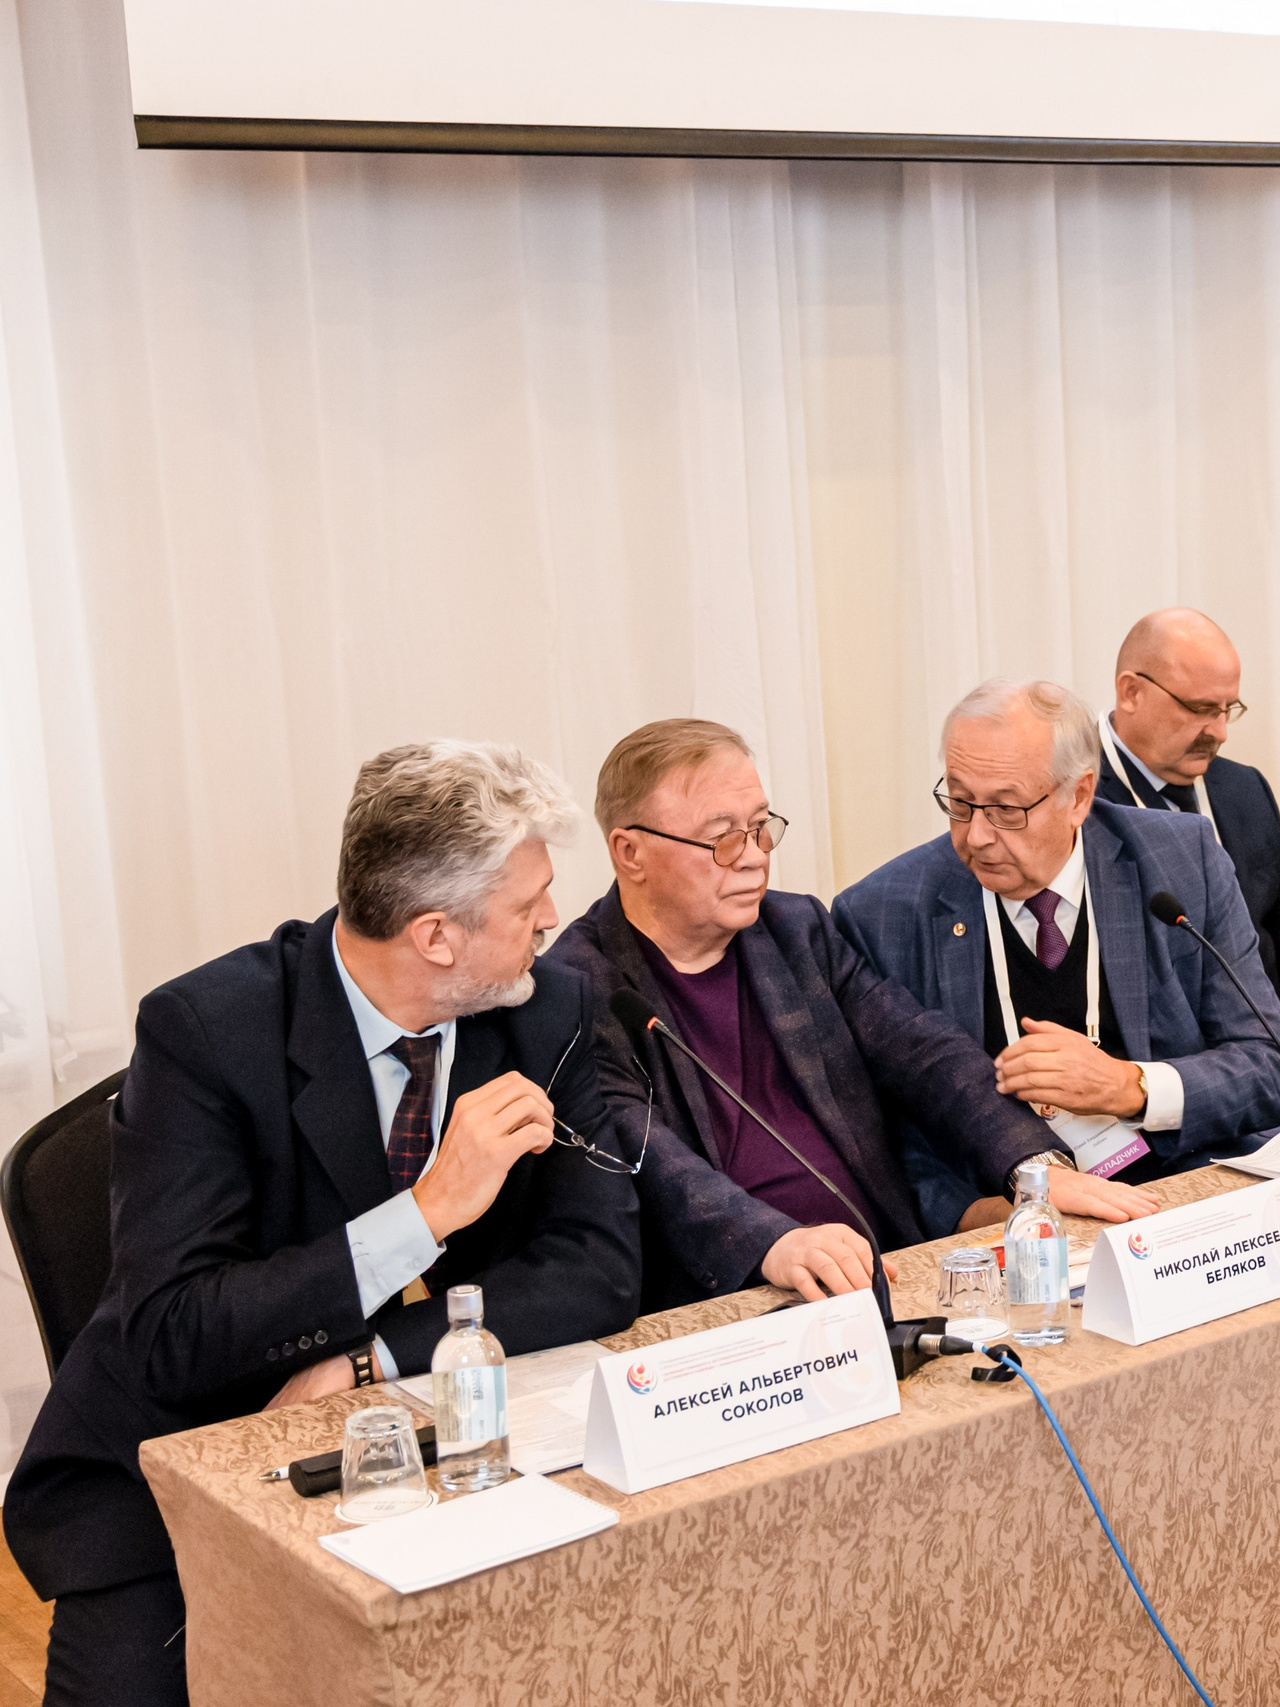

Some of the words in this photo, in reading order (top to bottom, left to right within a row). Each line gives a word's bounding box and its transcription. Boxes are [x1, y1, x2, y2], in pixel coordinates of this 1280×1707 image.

[1091, 1145, 1140, 1178] ОКЛАДЧИК
[1153, 1247, 1221, 1280] НИКОЛАЙ
[1205, 1255, 1266, 1285] БЕЛЯКОВ
[654, 1383, 734, 1419] АЛЕКСЕЙ
[739, 1349, 859, 1395] АЛЬБЕРТОВИЧ
[721, 1387, 804, 1422] СОКОЛОВ
